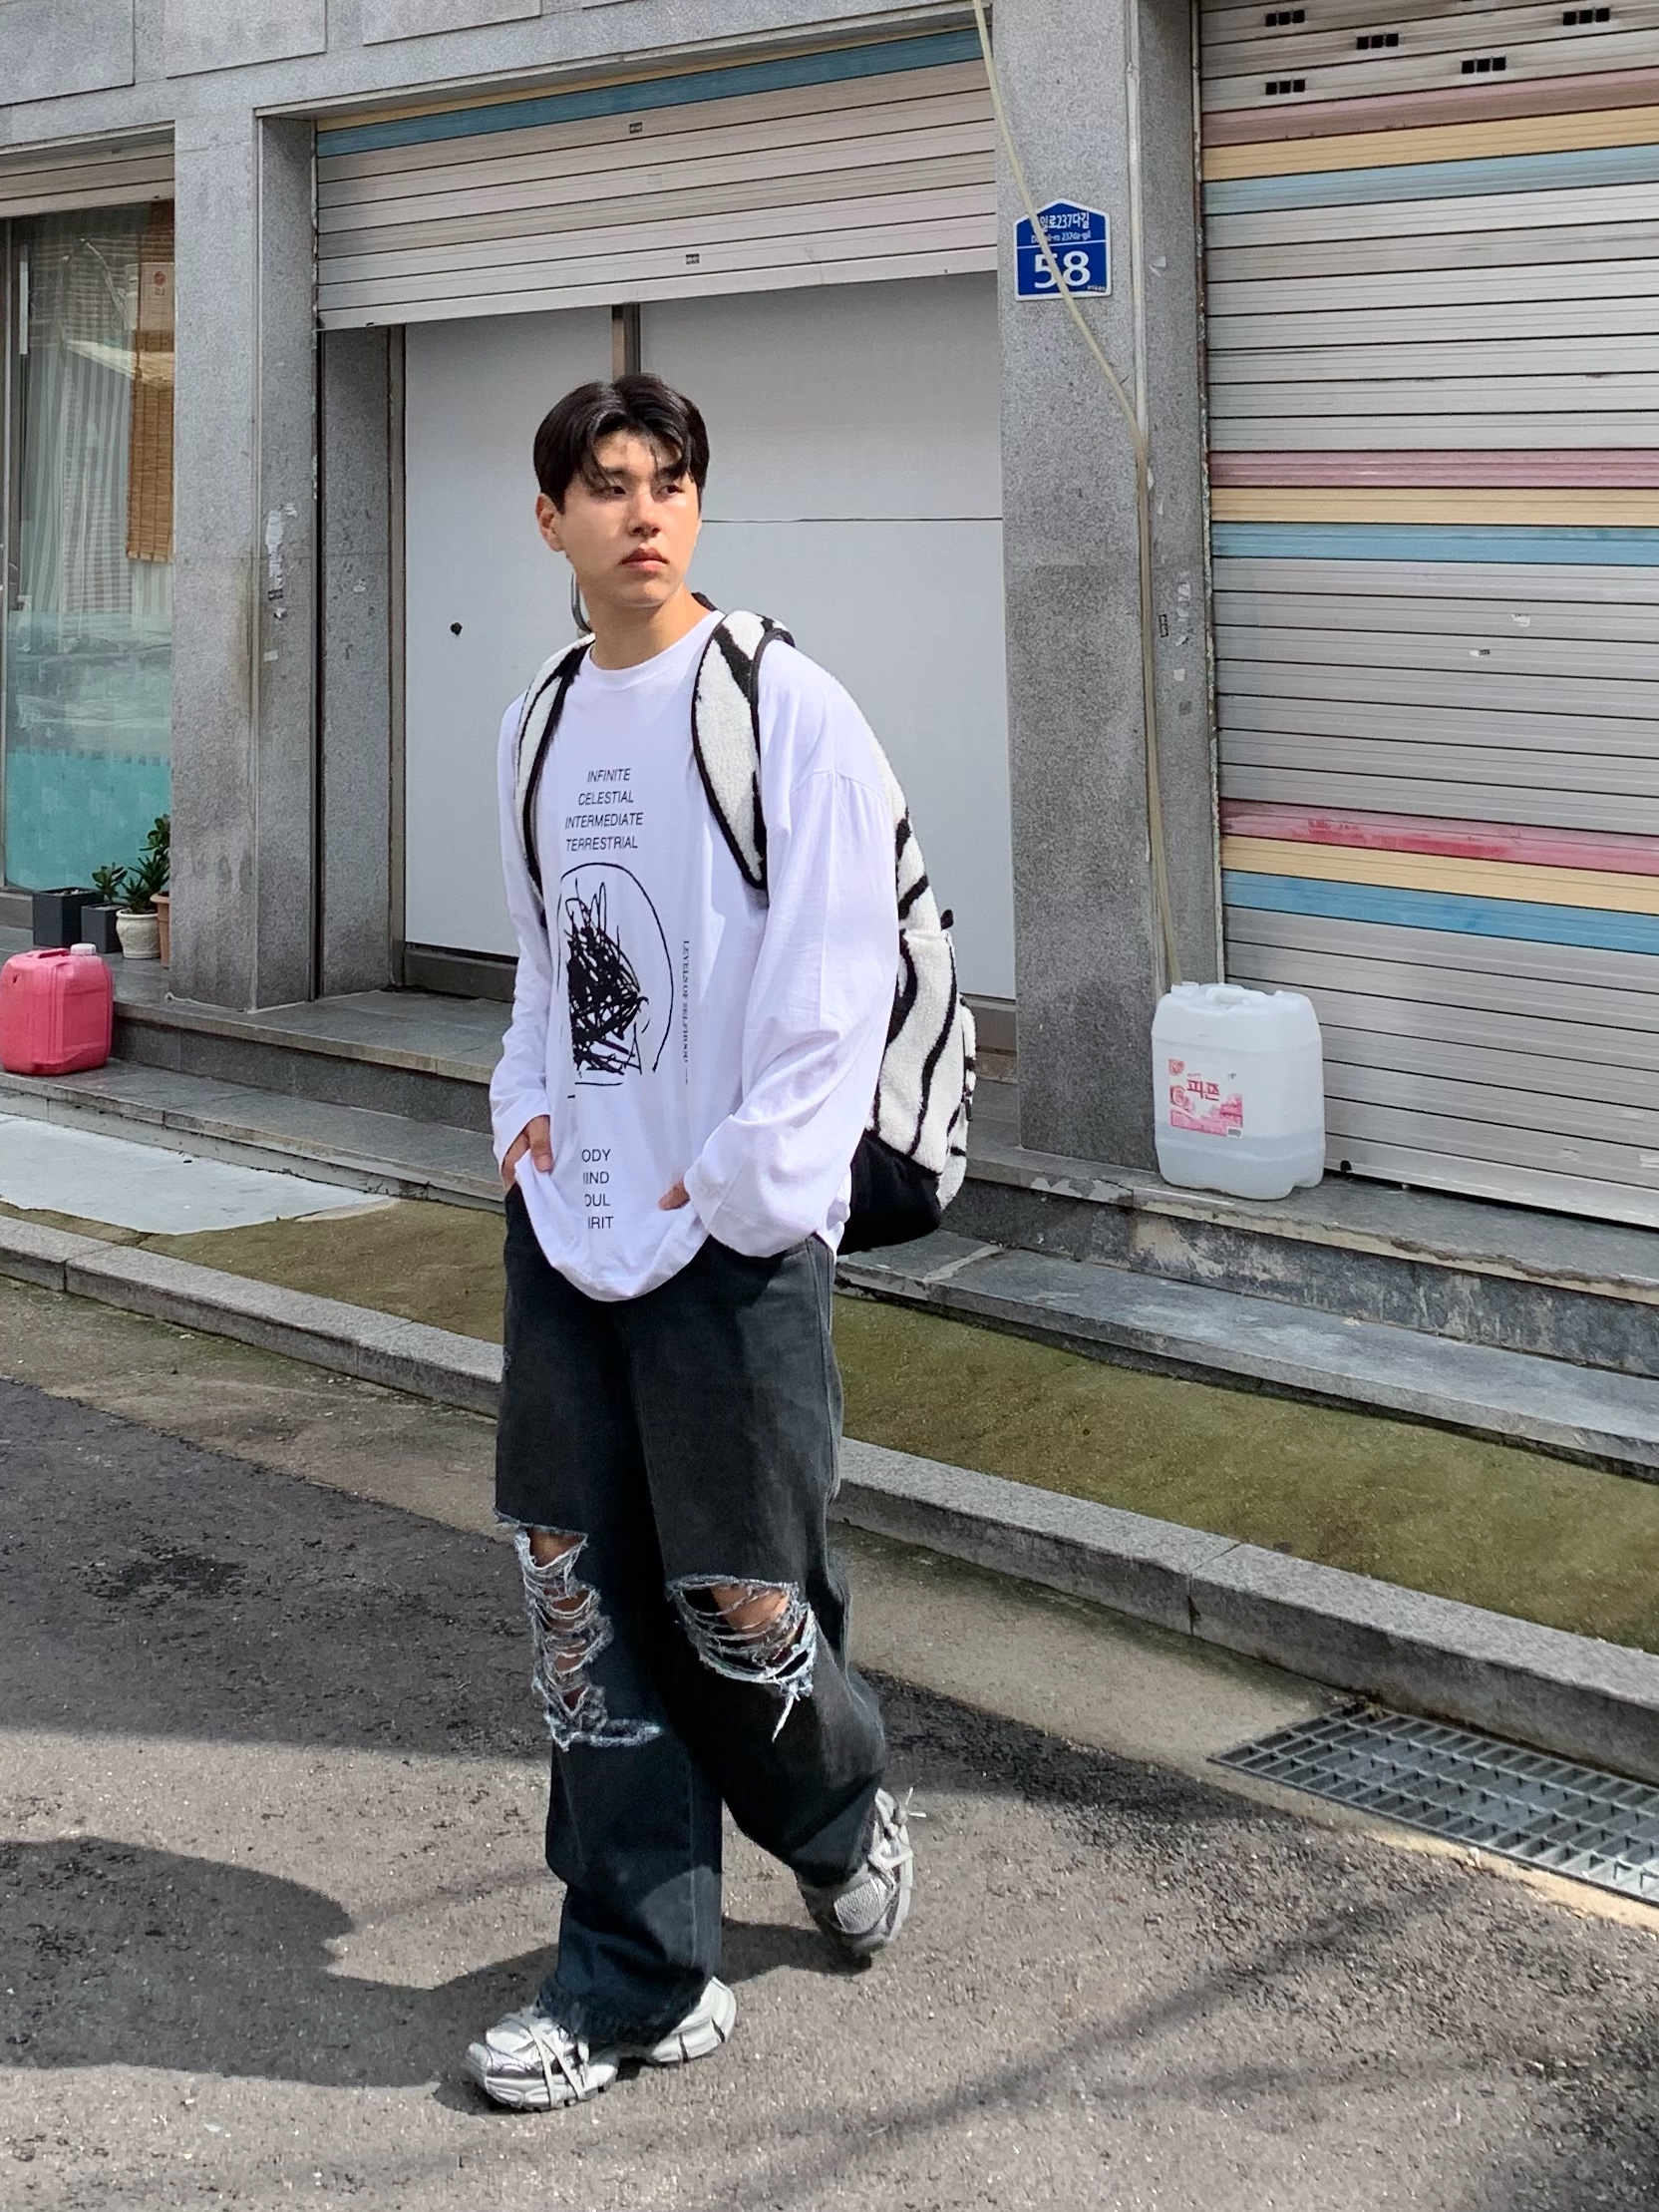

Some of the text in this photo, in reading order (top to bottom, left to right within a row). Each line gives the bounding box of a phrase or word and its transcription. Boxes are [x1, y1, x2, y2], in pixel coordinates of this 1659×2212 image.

[1040, 211, 1090, 232] 일로237다길
[1034, 250, 1091, 289] 58
[587, 768, 631, 783] INFINITE
[578, 791, 634, 806] CELESTIAL
[565, 812, 644, 829] INTERMEDIATE
[566, 836, 638, 852] TERRESTRIAL
